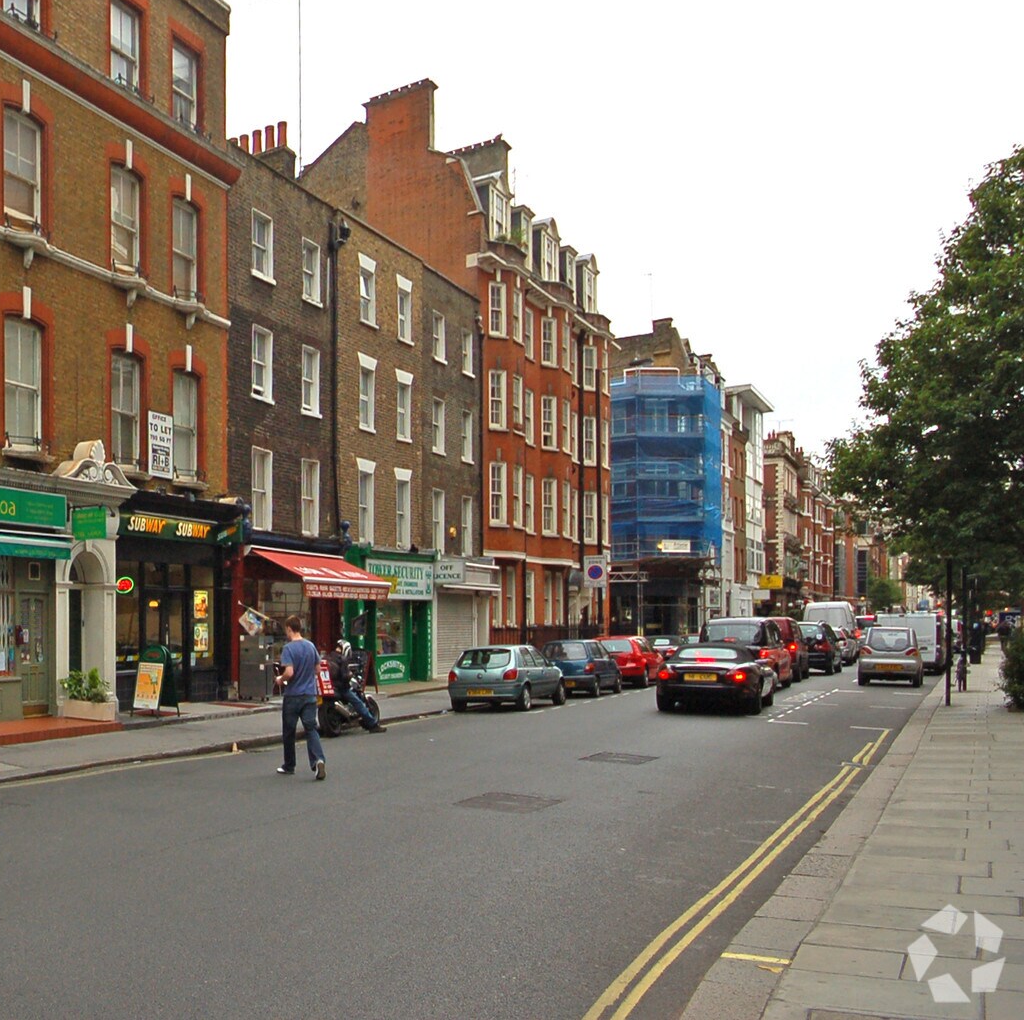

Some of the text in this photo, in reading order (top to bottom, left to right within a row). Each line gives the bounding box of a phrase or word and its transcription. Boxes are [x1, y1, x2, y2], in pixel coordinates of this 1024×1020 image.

[149, 422, 172, 436] TO LET
[127, 515, 166, 534] SUBWAY
[176, 521, 211, 539] SUBWAY
[393, 565, 424, 581] SECURITY
